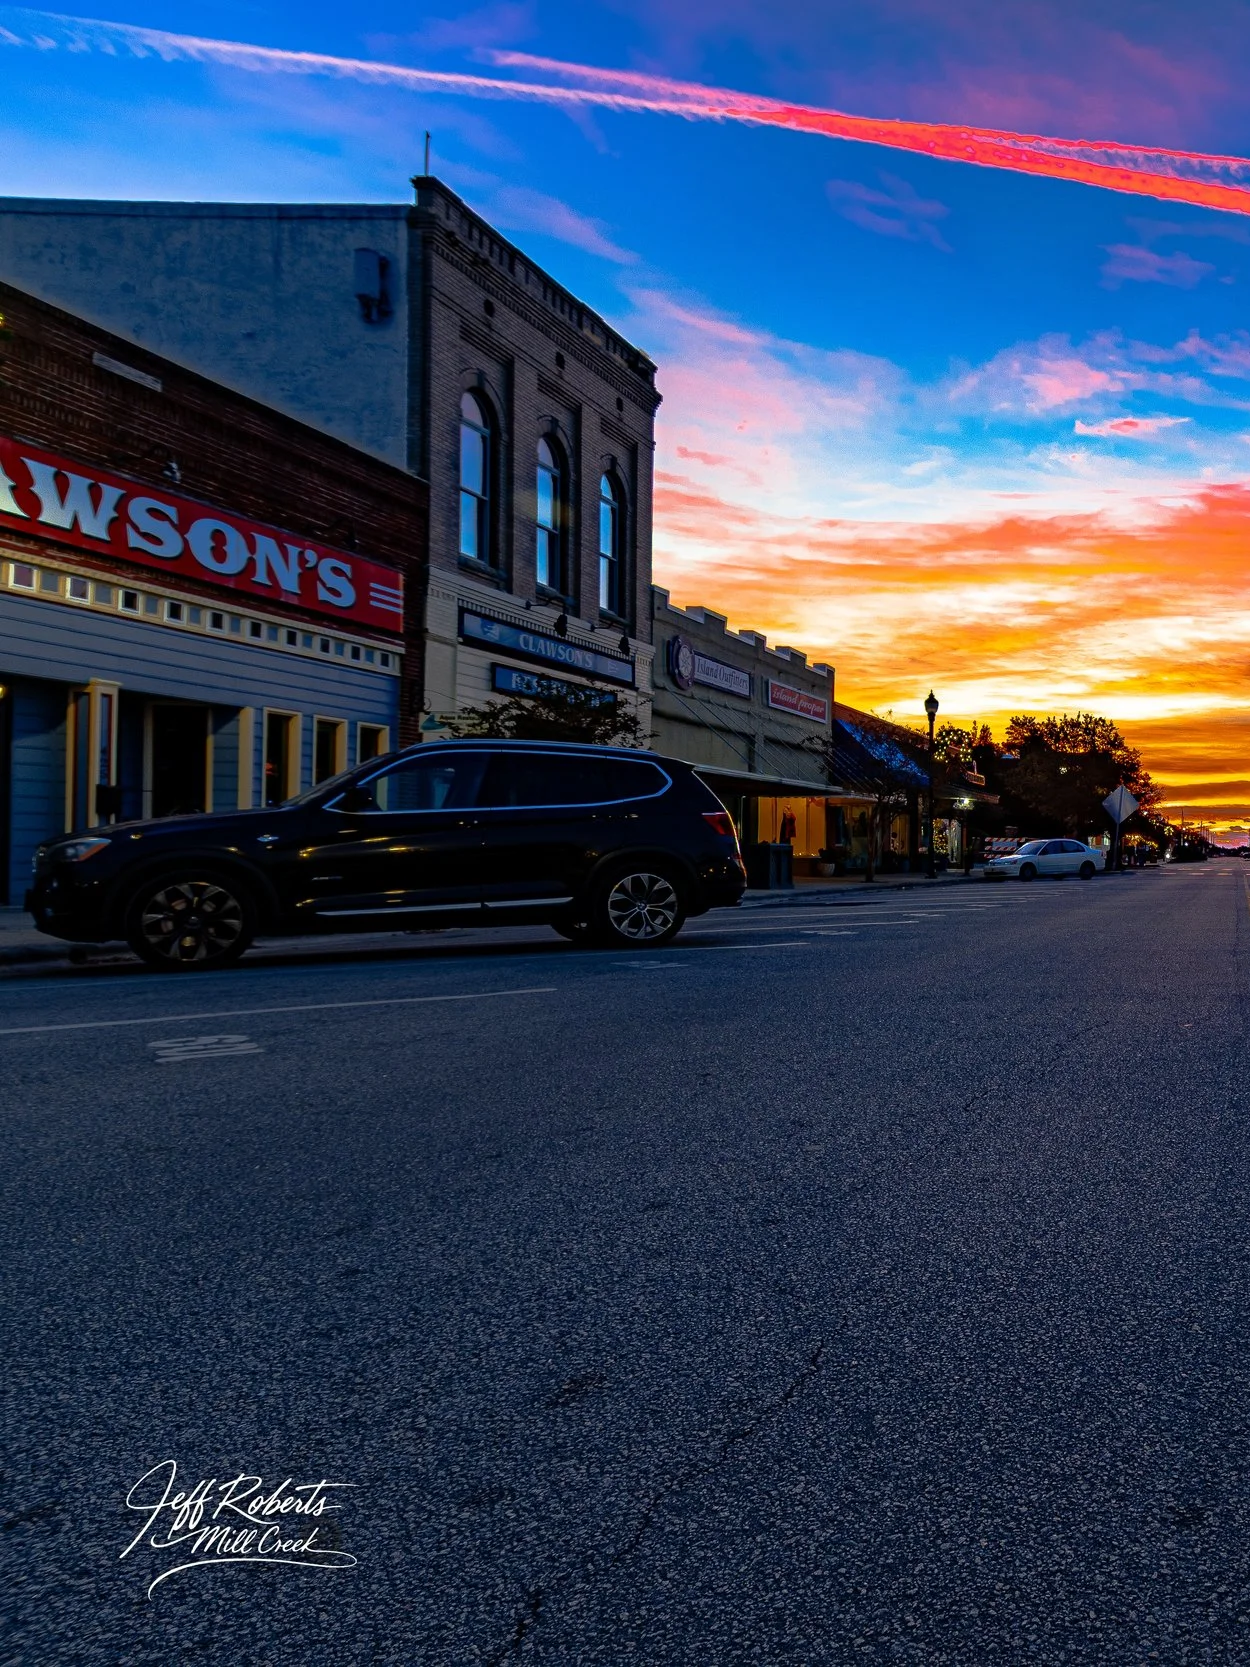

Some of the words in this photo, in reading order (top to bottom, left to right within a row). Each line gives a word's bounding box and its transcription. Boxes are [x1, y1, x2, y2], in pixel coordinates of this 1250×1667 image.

[519, 634, 593, 669] CLAWSON'S
[697, 658, 718, 679] Island
[719, 667, 748, 689] Outfitters
[772, 688, 799, 705] island
[797, 699, 824, 715] proper
